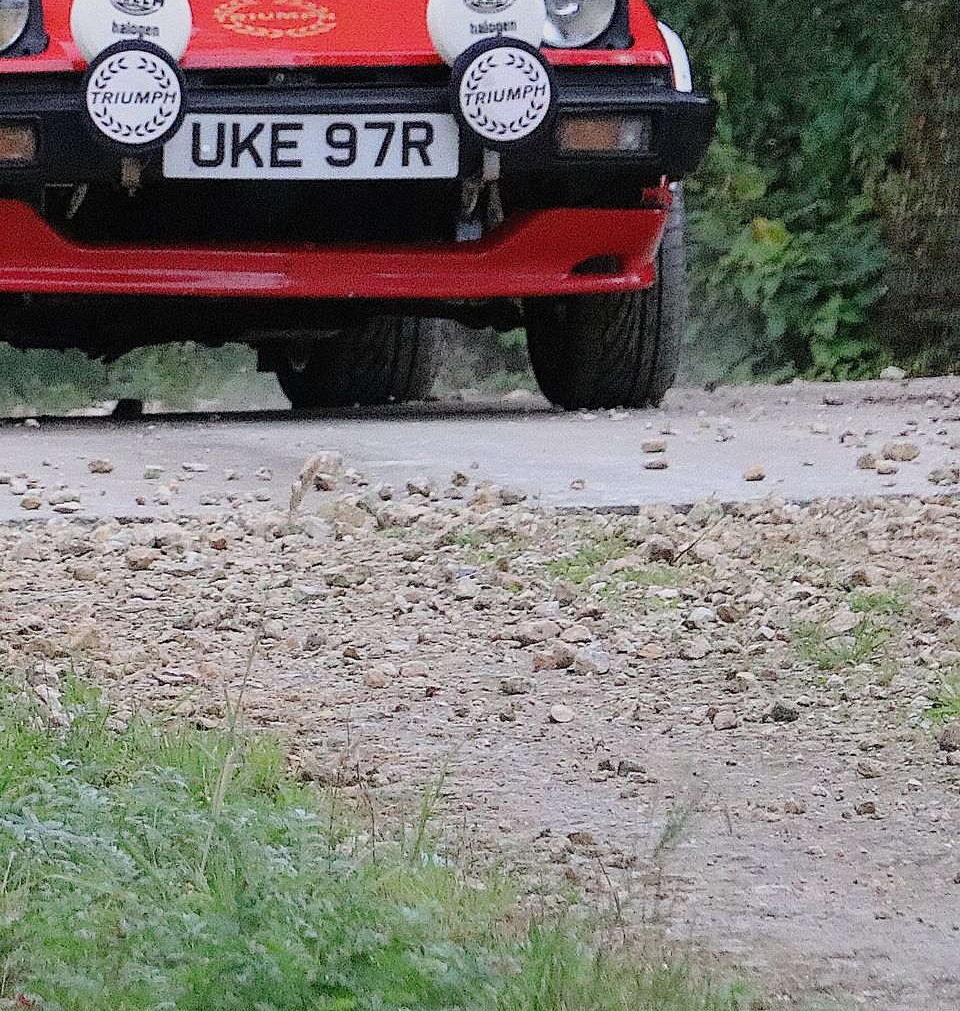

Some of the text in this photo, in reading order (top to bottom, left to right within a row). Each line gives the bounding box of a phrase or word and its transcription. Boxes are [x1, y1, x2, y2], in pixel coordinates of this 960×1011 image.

[111, 20, 161, 38] halogen
[469, 20, 518, 37] halogen
[91, 91, 178, 105] TRIUMPH
[465, 84, 547, 106] TRIUMPH
[191, 120, 435, 169] UKE 97R
